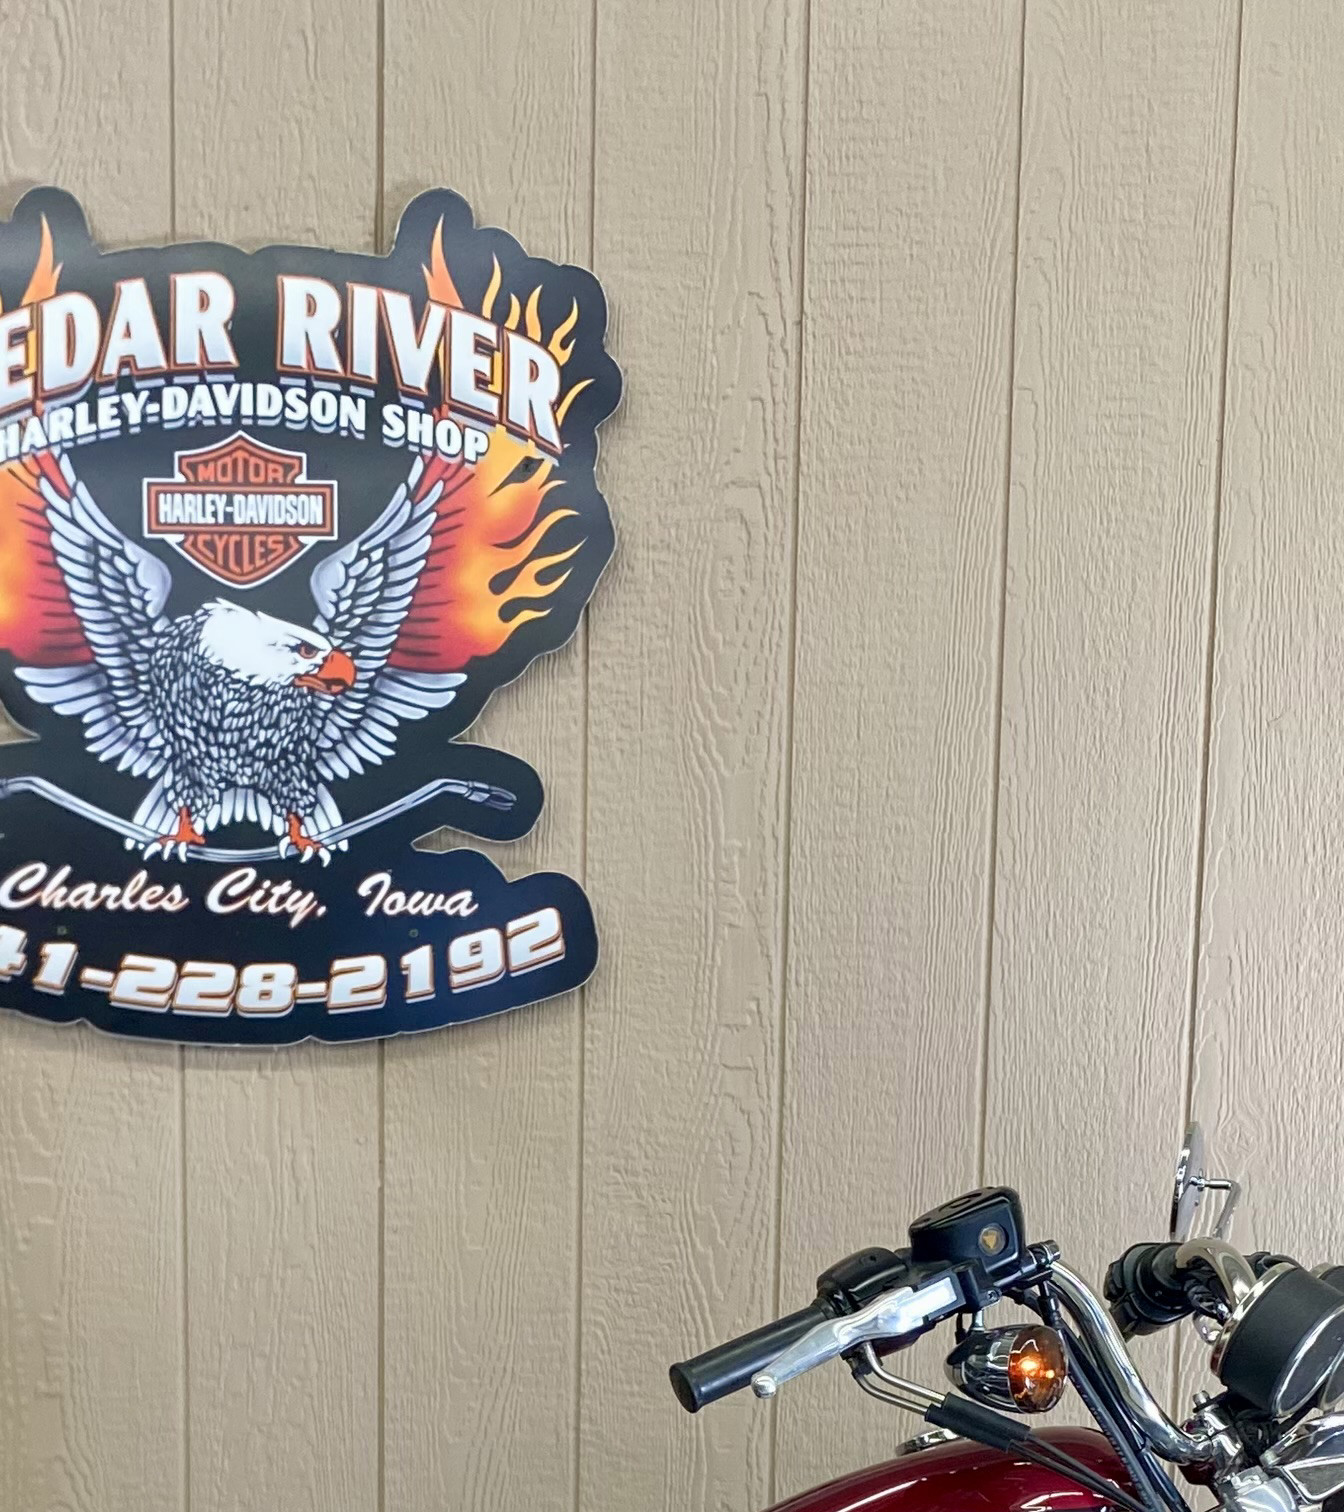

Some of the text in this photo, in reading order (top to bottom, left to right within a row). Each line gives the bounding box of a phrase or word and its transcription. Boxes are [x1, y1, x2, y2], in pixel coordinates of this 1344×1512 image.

[276, 273, 563, 454] RIVER
[382, 402, 490, 463] SHOP
[197, 450, 284, 483] MOTOR
[158, 492, 324, 525] HARLEY-DAVIDSON
[196, 533, 284, 574] CYCLES
[206, 866, 328, 928] City,
[357, 871, 479, 919] Iowa
